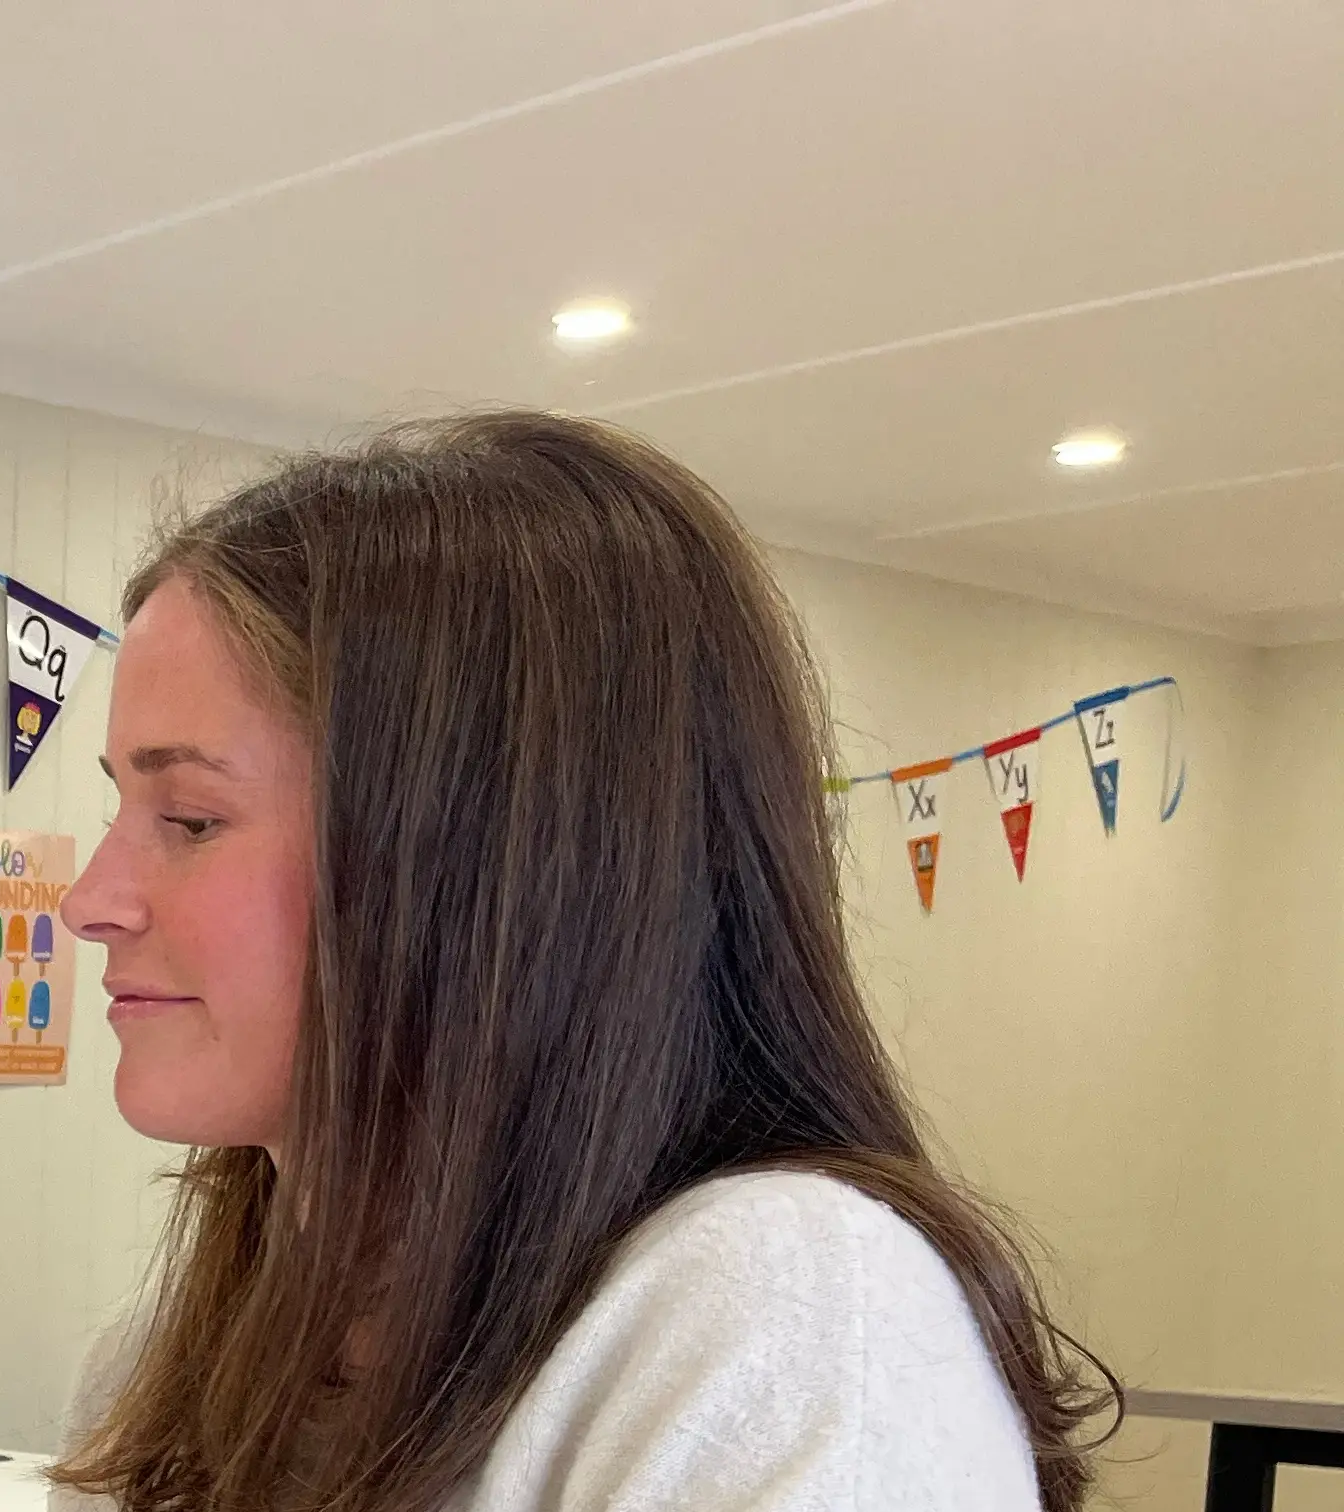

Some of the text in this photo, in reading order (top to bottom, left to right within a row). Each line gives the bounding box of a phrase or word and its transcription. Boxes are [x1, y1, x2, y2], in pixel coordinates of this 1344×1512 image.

[19, 615, 66, 702] Qq
[907, 779, 937, 823] Xx
[999, 750, 1029, 805] Yy
